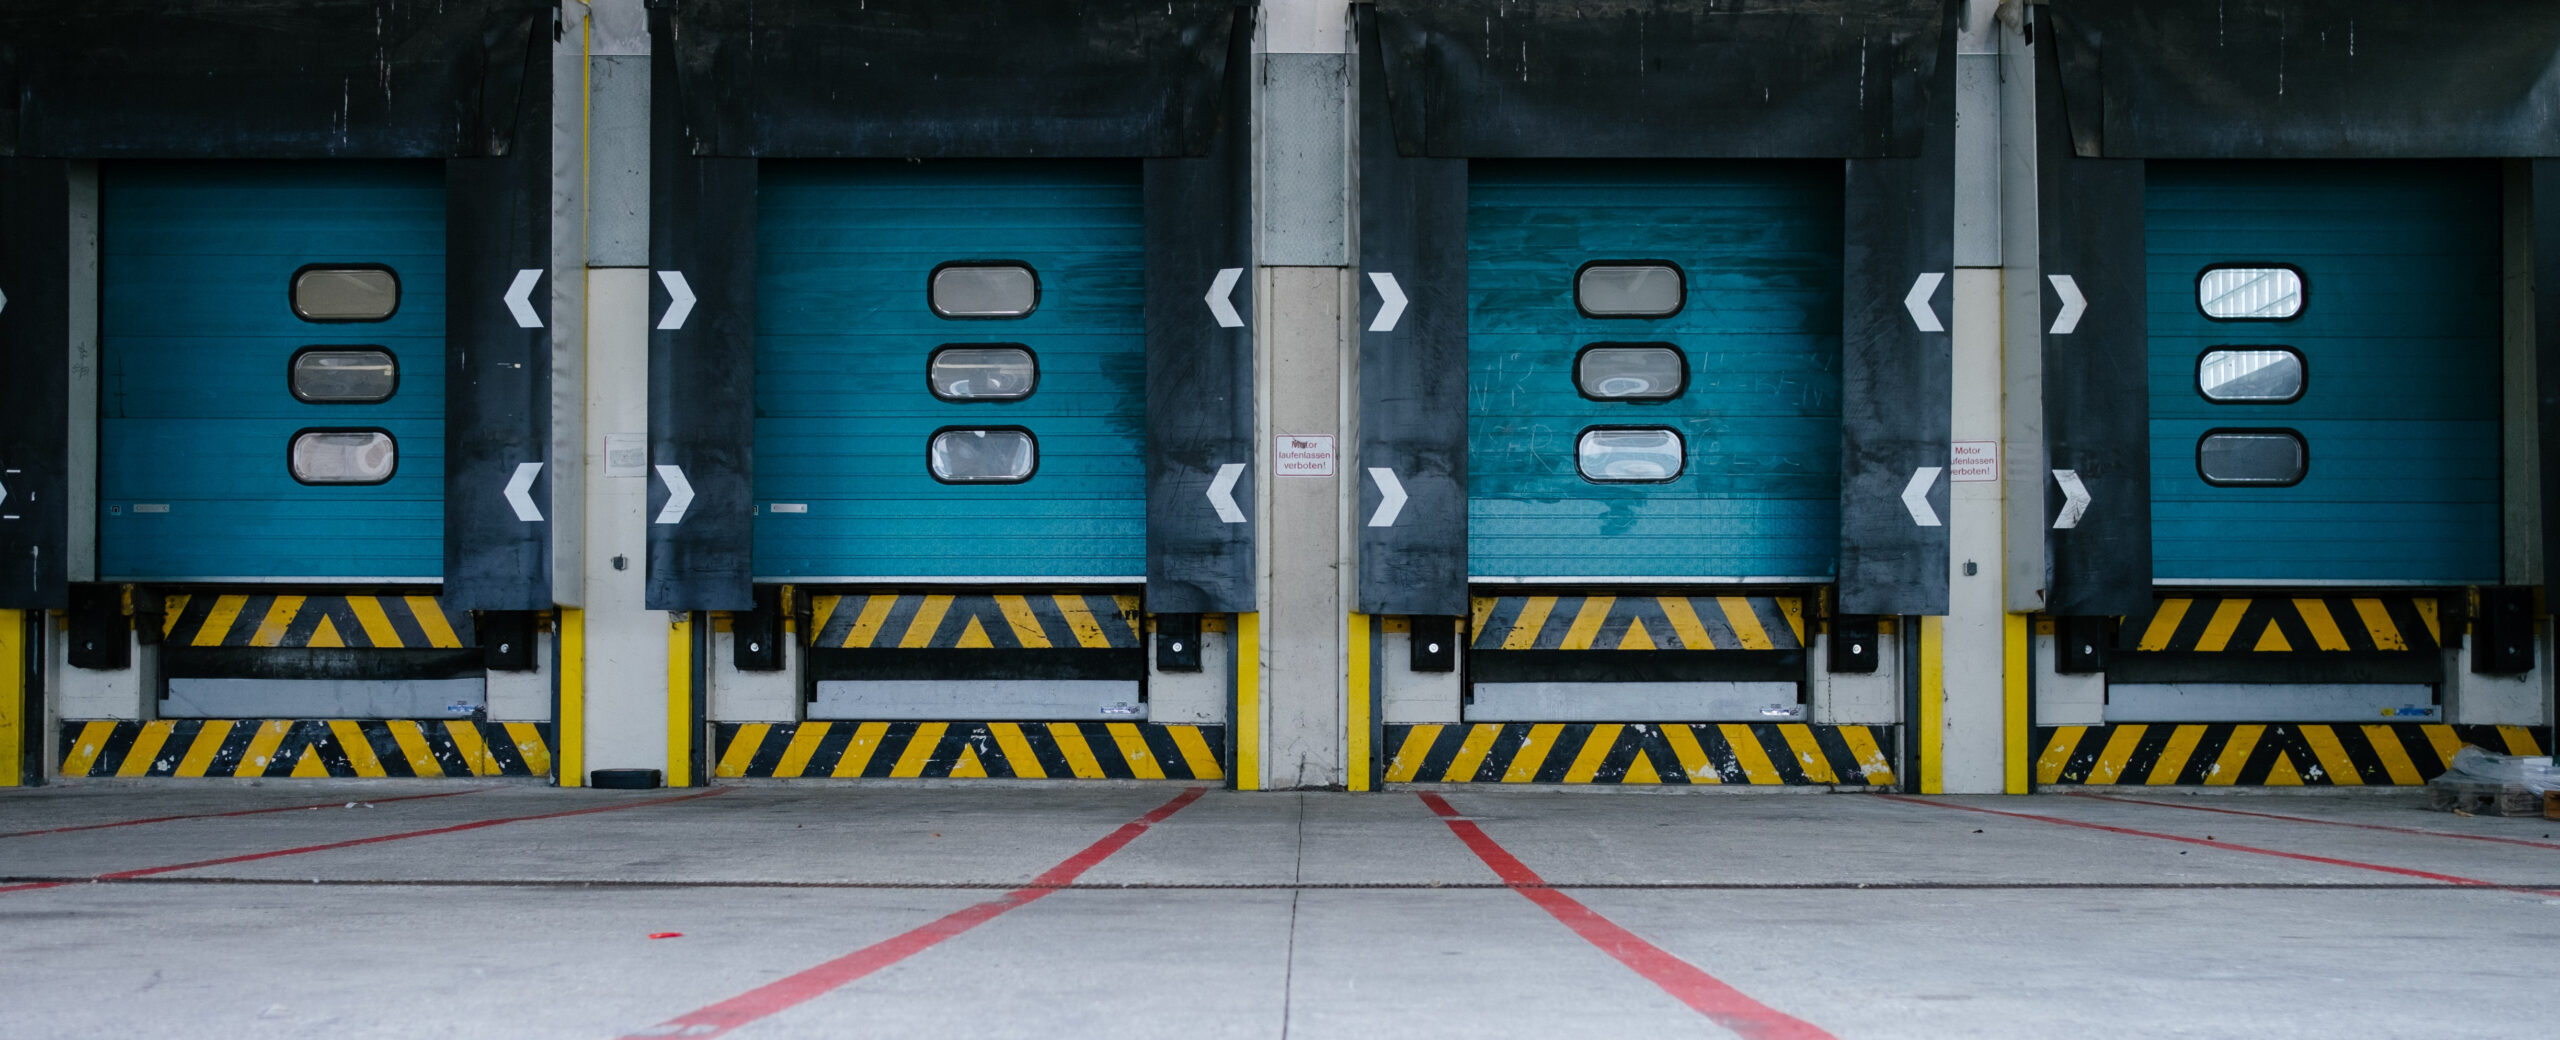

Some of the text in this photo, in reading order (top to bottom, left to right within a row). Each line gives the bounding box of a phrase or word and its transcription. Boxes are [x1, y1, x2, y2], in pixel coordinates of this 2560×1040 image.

[1279, 451, 1331, 459] laufenlassen
[1955, 447, 1981, 455] Motor
[1951, 457, 1994, 465] ufenlassen
[1284, 461, 1326, 470] verboten!
[1951, 467, 1990, 475] erboten!
